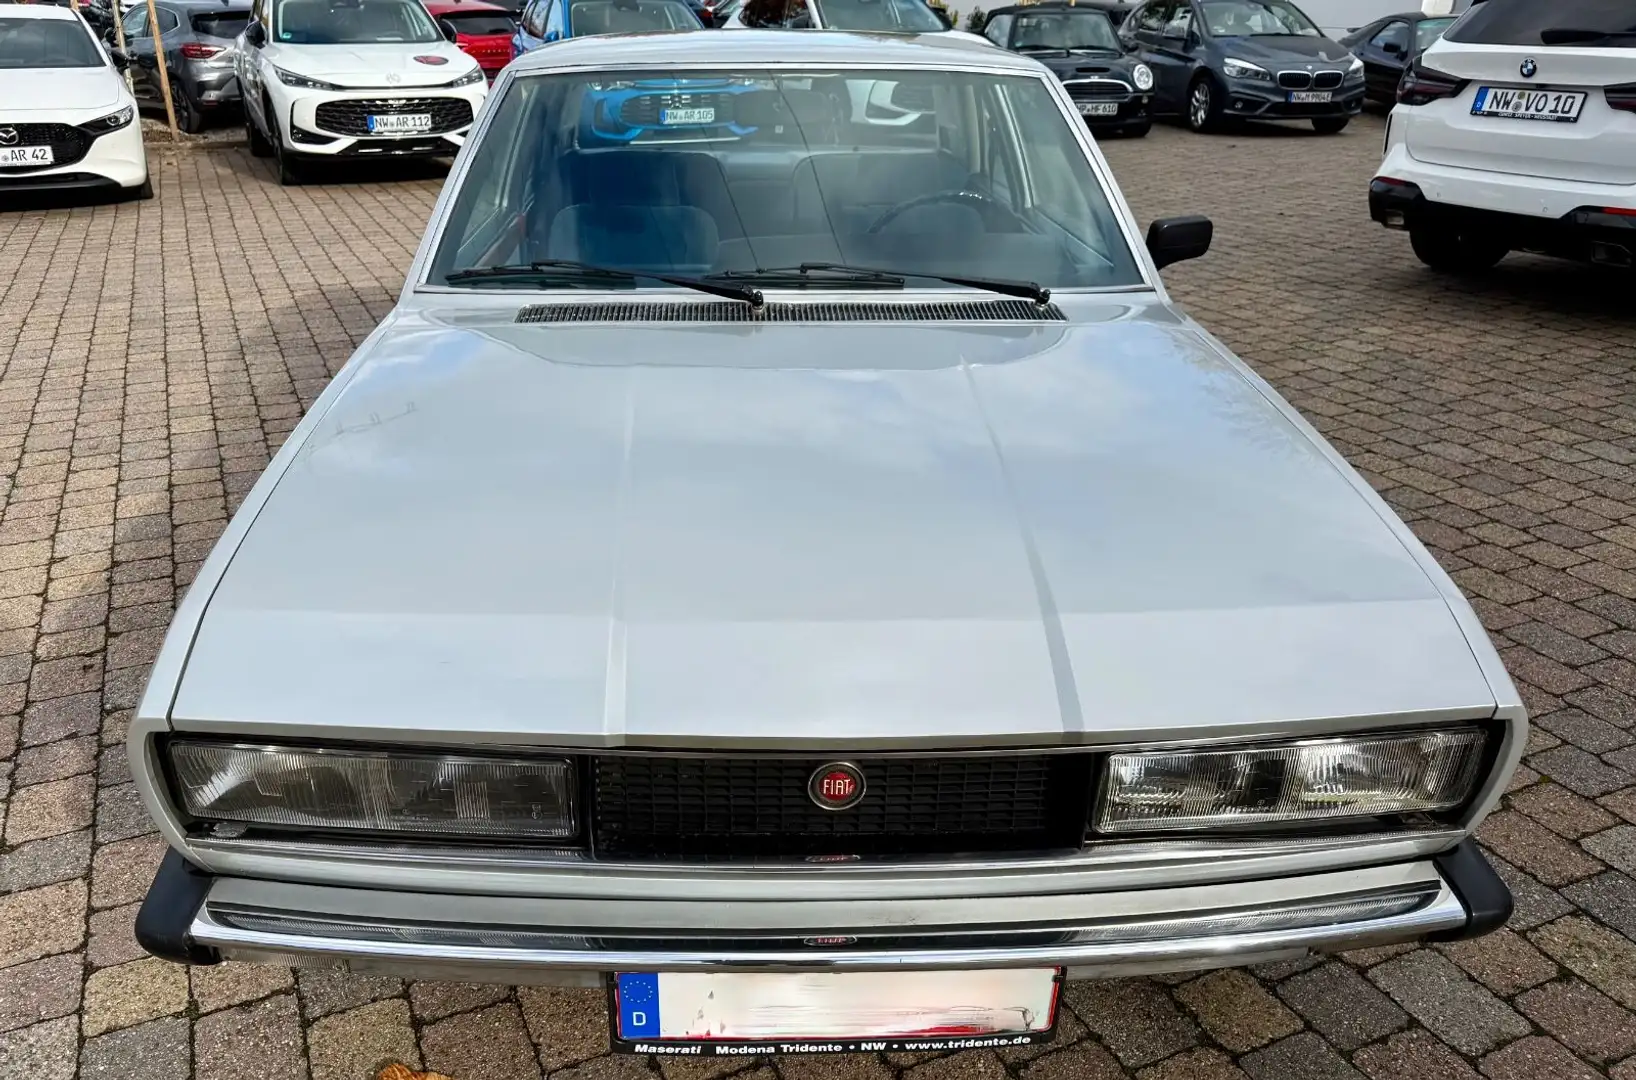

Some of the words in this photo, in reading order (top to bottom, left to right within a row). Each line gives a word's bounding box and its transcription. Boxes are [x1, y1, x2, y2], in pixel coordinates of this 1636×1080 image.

[1102, 104, 1117, 113] 610
[1488, 90, 1516, 110] NW
[1525, 92, 1548, 113] VO
[1548, 95, 1576, 115] 10
[374, 117, 389, 128] NW
[396, 116, 409, 127] AR
[411, 116, 430, 127] 112
[666, 111, 678, 121] NW
[684, 110, 695, 120] AR
[696, 110, 714, 120] 105
[11, 149, 28, 162] AR
[31, 148, 49, 161] 42
[823, 779, 850, 795] FIAT
[632, 1011, 646, 1026] D
[634, 1044, 702, 1055] Maserati
[715, 1045, 776, 1055] Modena
[780, 1043, 843, 1054] Tridente
[860, 1042, 888, 1052] NW
[905, 1035, 1032, 1052] www.tridente.de
